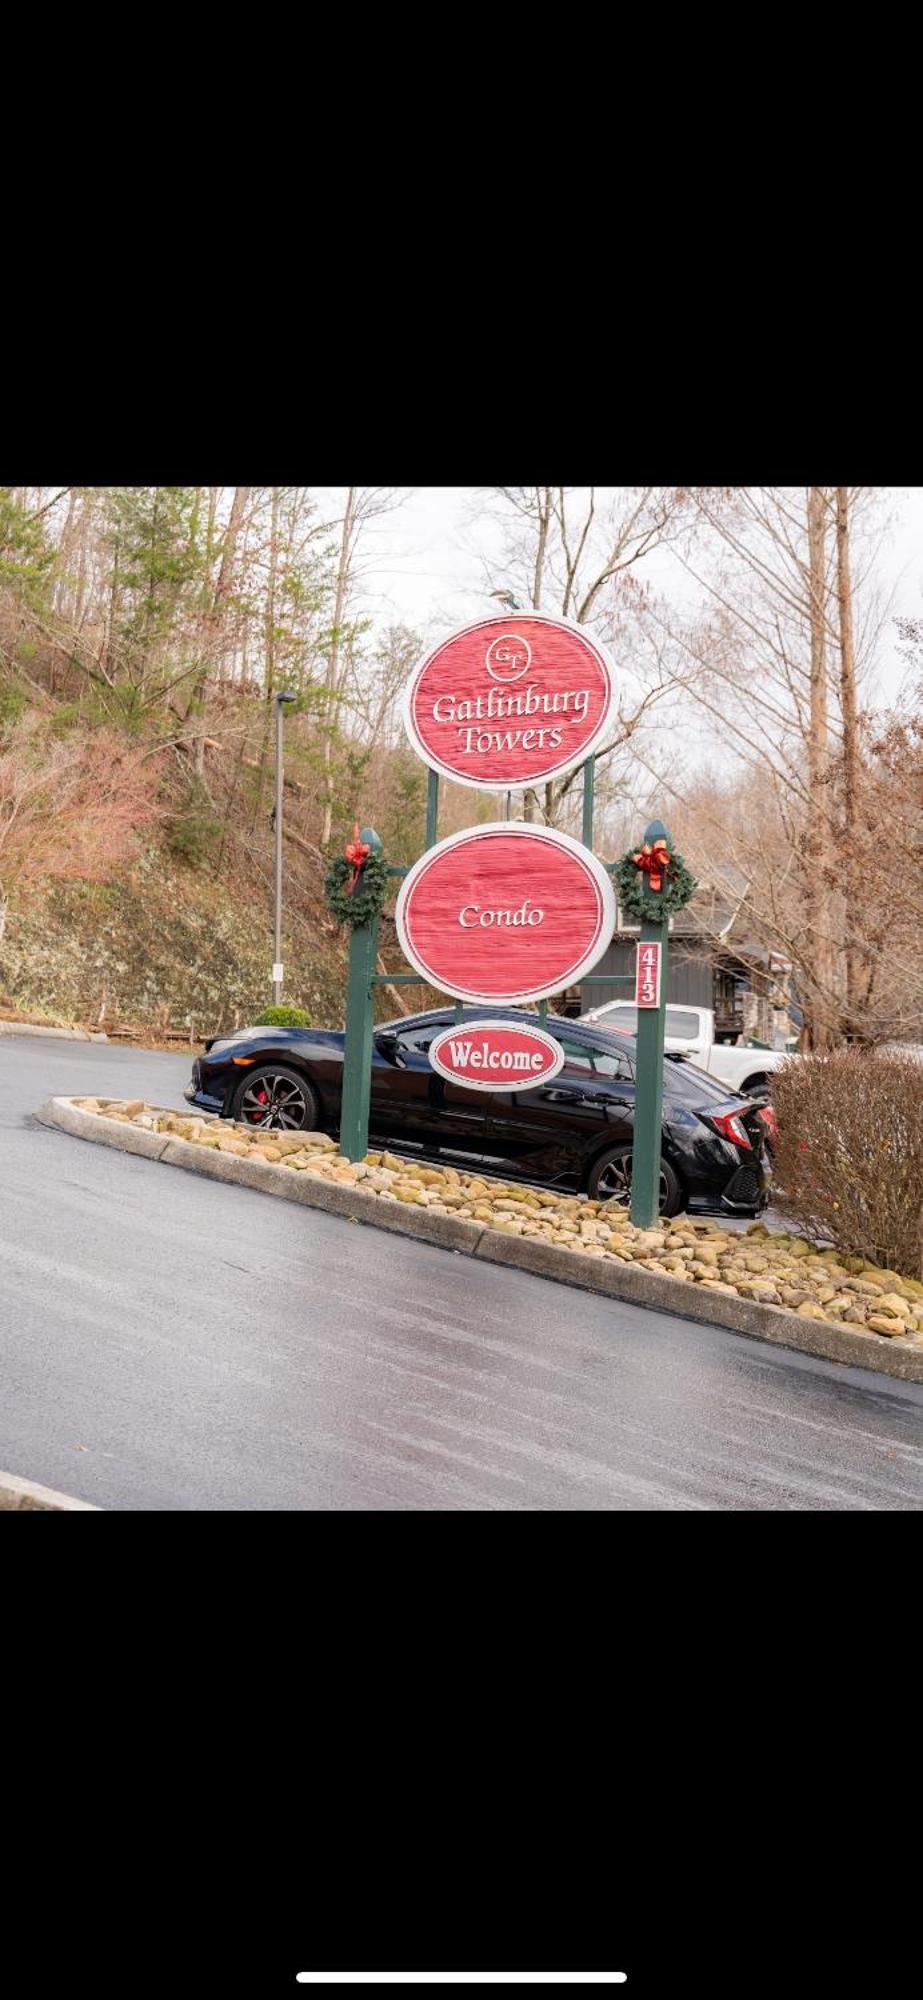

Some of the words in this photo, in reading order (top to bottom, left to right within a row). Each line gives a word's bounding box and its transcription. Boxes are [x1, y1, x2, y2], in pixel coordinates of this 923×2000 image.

[432, 684, 591, 722] Gatlinburg
[458, 727, 563, 754] Towers
[459, 901, 545, 928] Condo
[642, 949, 656, 1001] 413
[449, 1041, 544, 1071] Welcome
